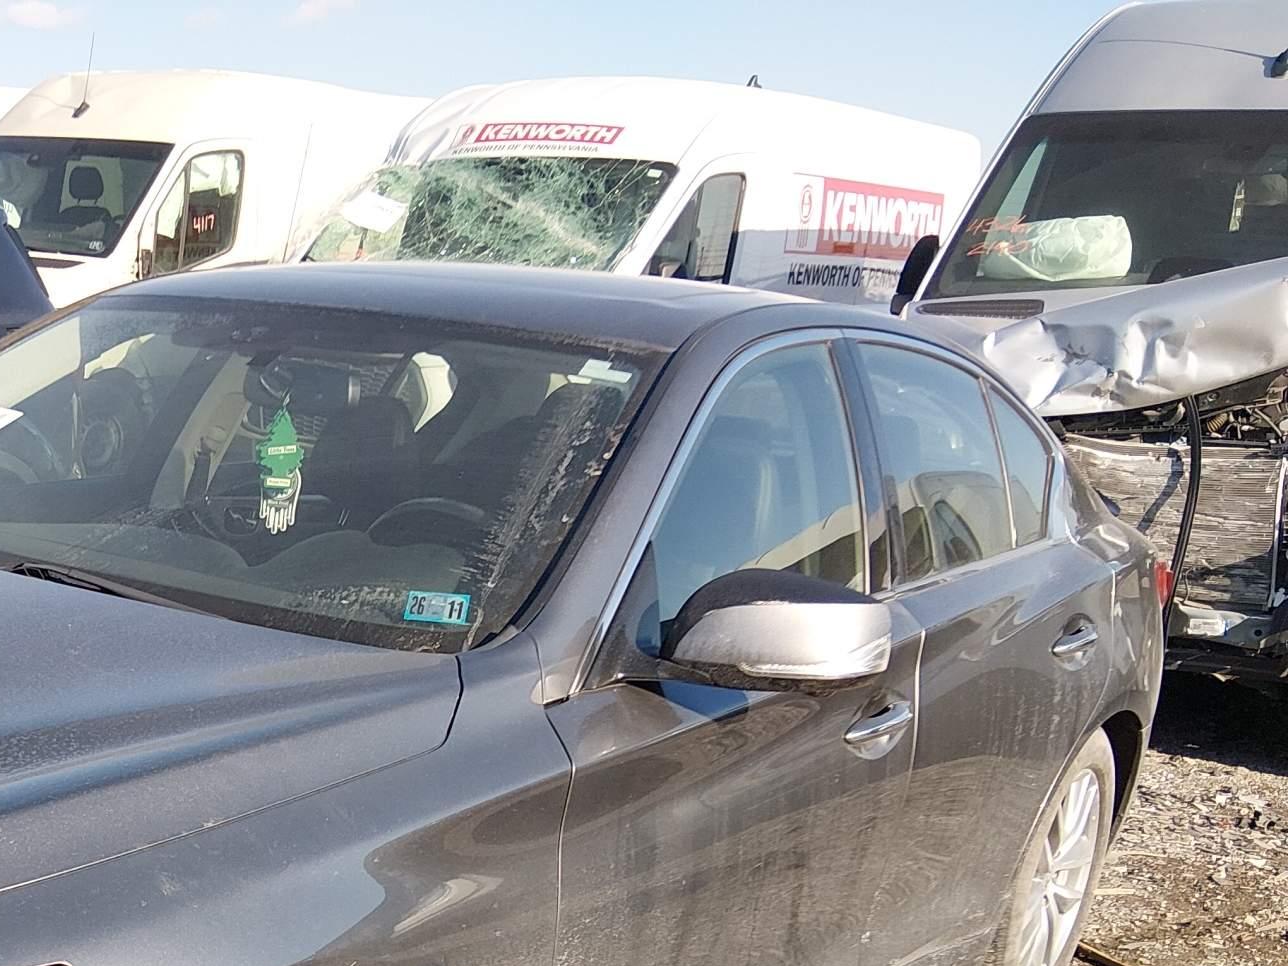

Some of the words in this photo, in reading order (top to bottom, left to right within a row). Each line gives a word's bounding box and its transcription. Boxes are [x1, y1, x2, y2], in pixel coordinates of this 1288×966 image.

[481, 124, 618, 142] KENWORTH
[193, 213, 215, 234] 4117
[823, 191, 941, 246] KENWORTH
[787, 262, 850, 287] KENWORTH
[851, 265, 868, 288] OF
[409, 596, 426, 615] 26
[448, 600, 464, 619] 11
